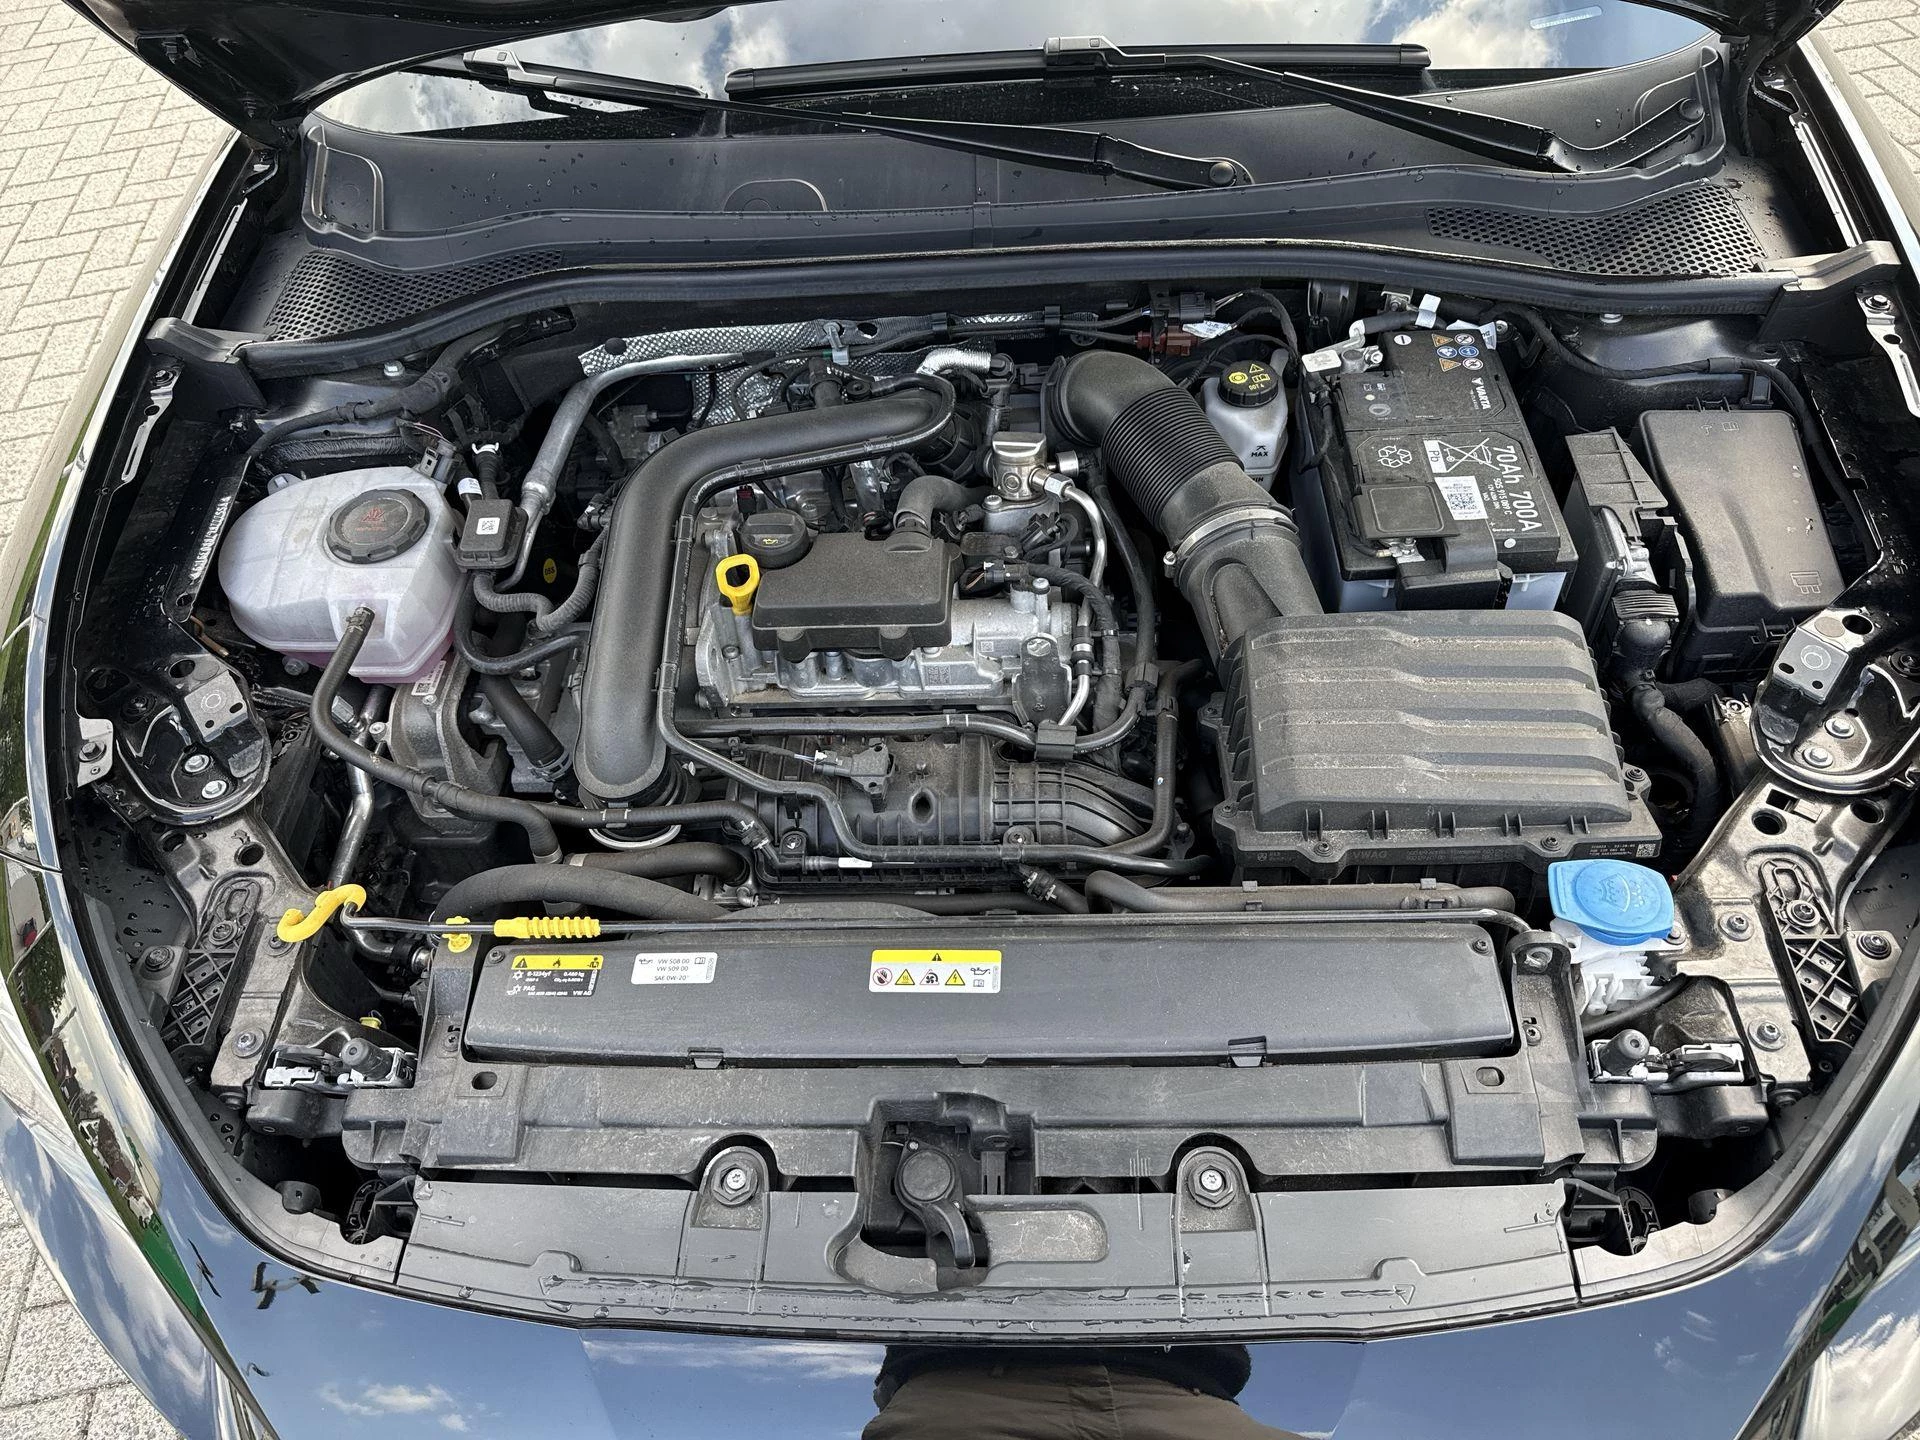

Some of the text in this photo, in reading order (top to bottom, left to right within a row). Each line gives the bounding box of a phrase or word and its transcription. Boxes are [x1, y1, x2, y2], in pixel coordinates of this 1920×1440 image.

[1475, 385, 1491, 410] VARTA
[1428, 450, 1440, 462] Pb
[1493, 445, 1543, 532] 70Ah 700A
